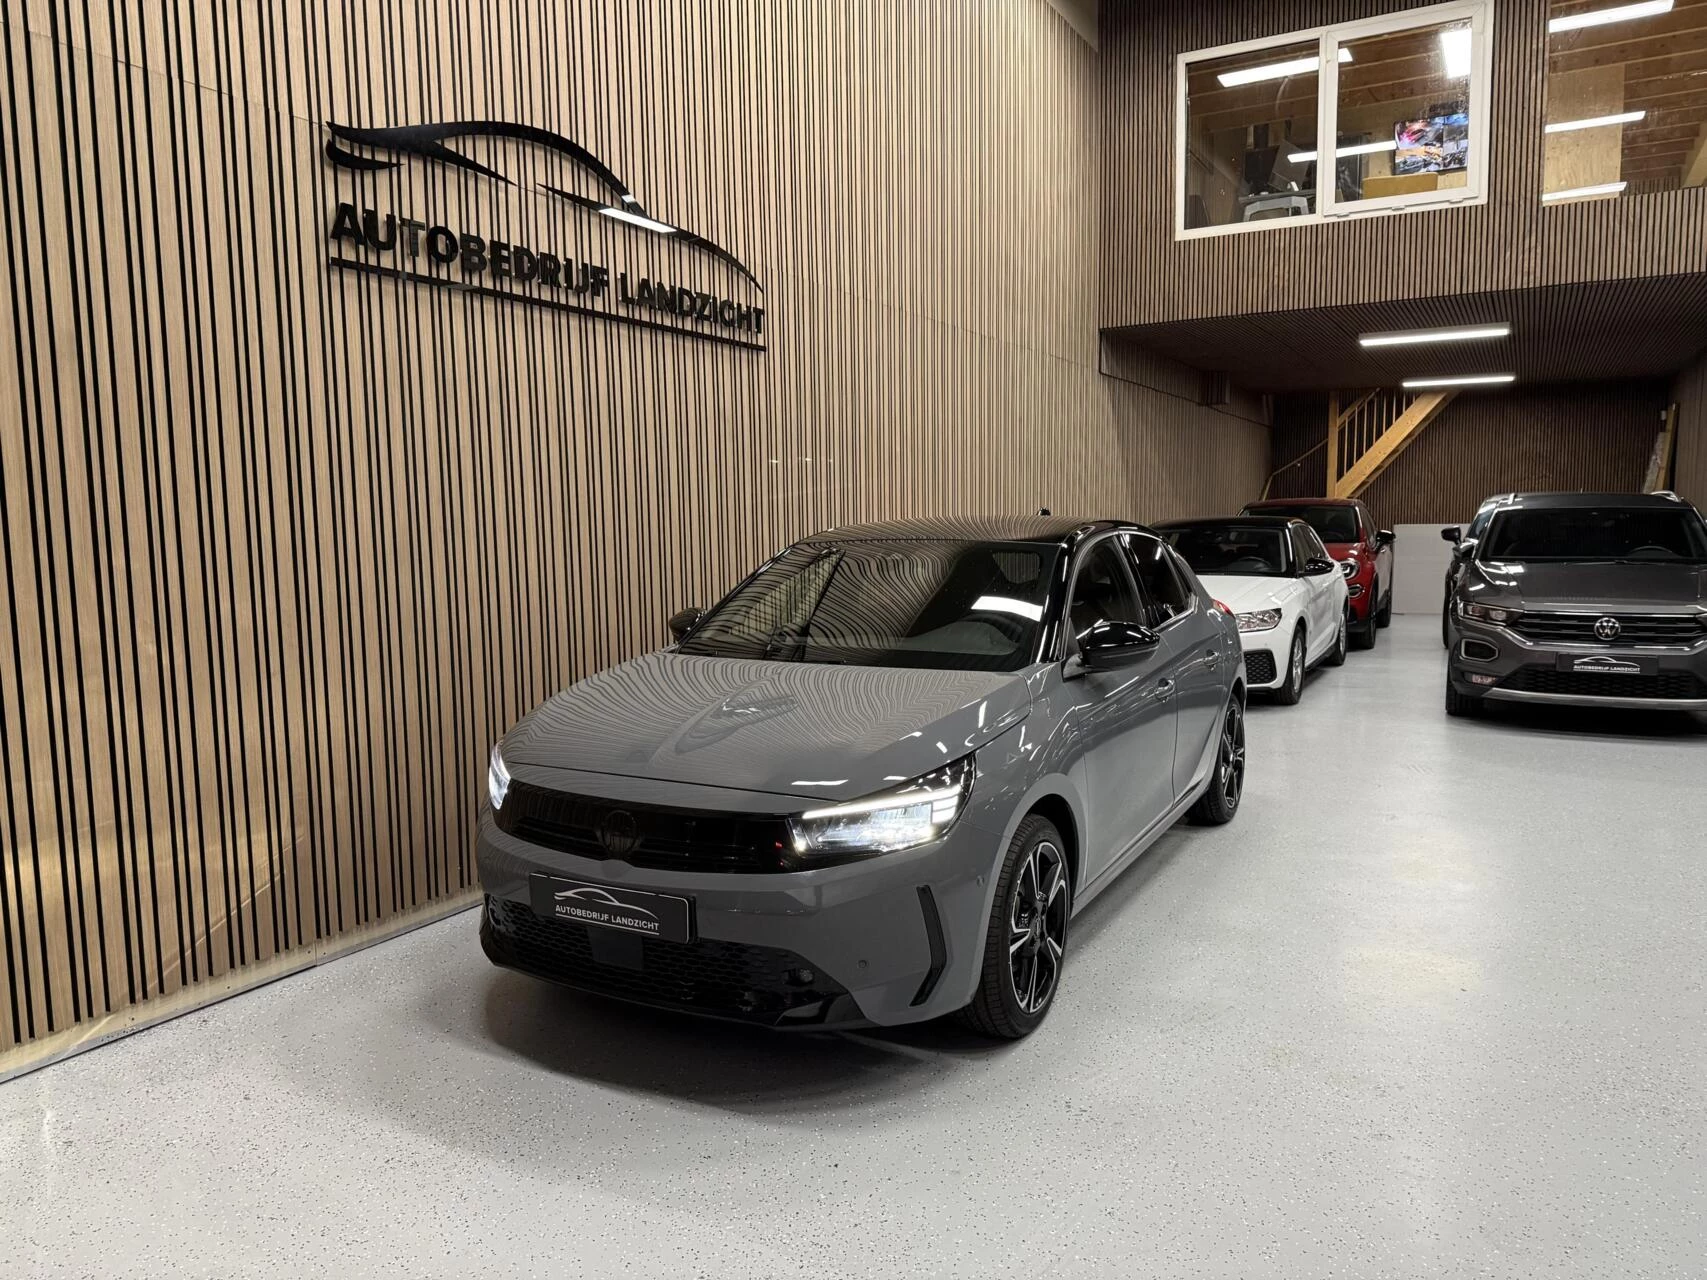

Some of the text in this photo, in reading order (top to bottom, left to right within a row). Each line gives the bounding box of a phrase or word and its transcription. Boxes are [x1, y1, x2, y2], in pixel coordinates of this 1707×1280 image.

[330, 202, 766, 335] AUTOBEDRIJF LANDZICHT
[555, 904, 660, 931] AUTOBEDRIJF LANDZICHT
